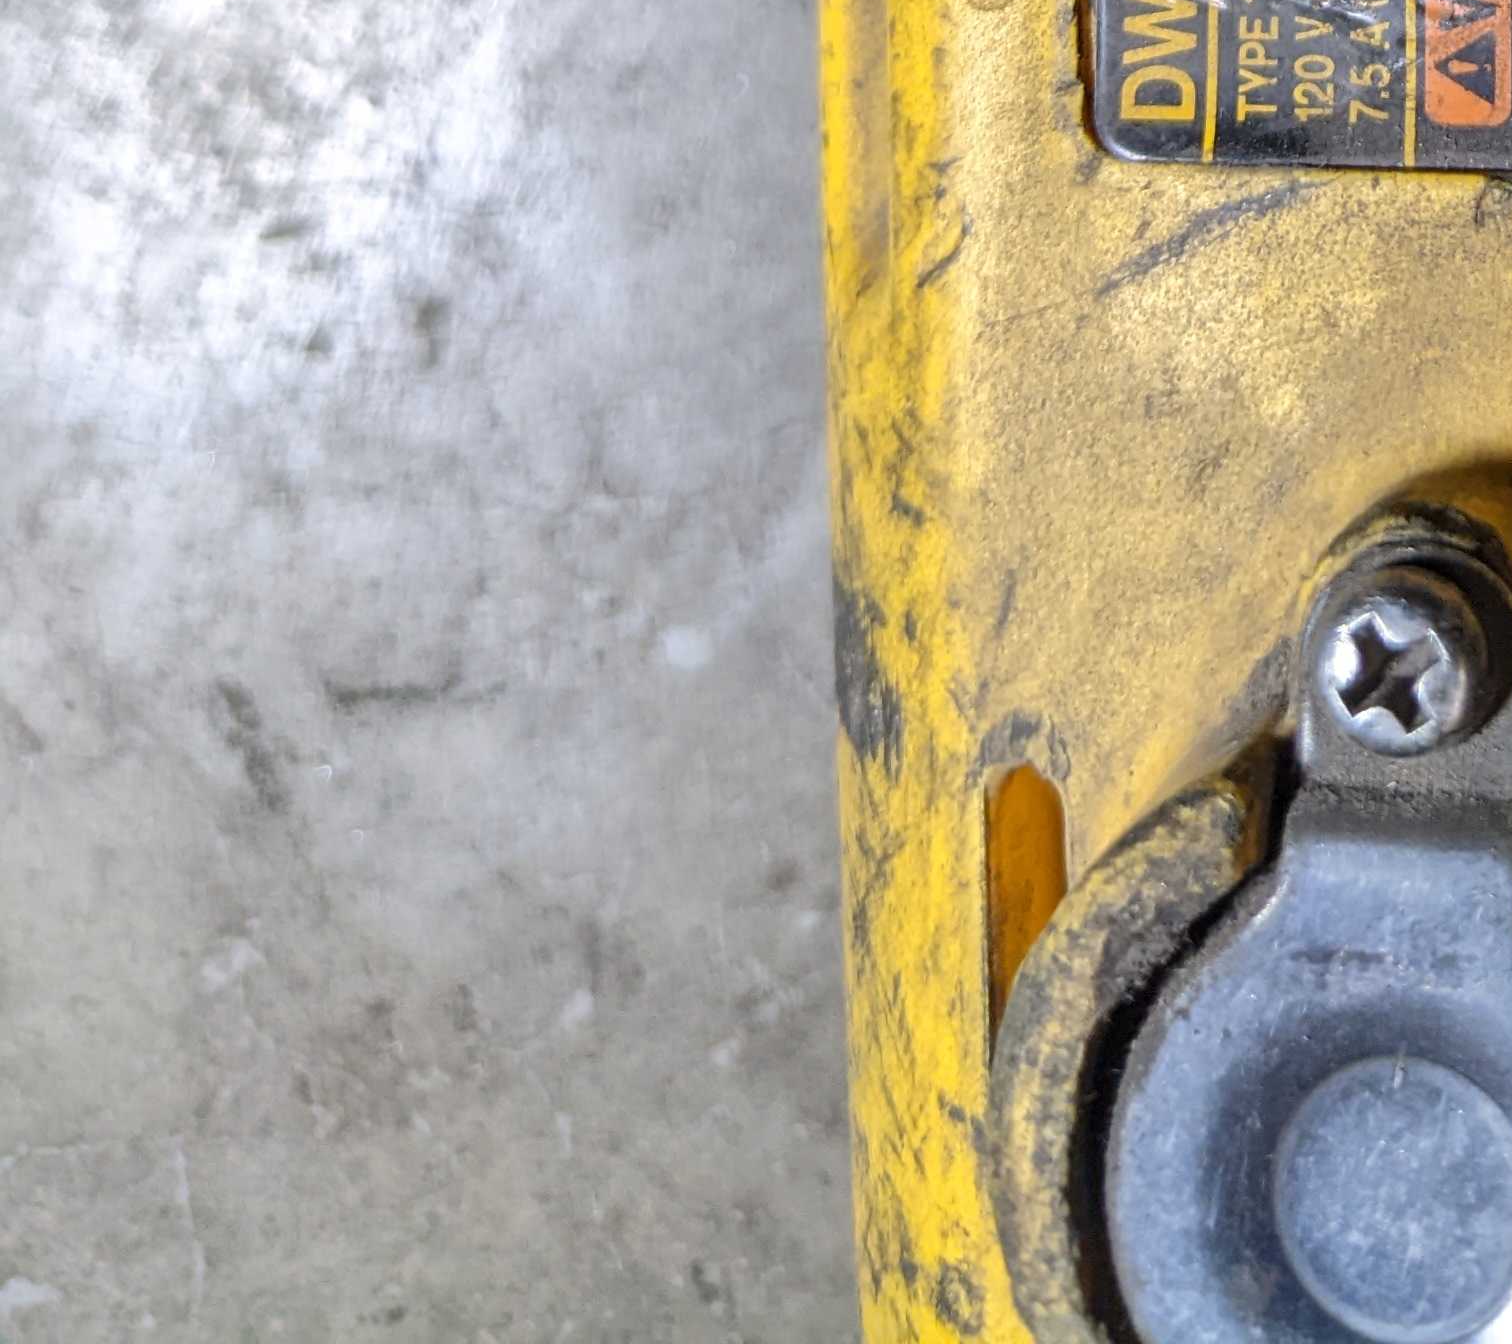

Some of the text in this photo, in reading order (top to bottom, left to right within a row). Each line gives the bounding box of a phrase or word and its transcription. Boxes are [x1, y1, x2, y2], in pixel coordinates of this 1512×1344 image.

[1295, 15, 1335, 39] V
[1349, 20, 1391, 51] A
[1238, 15, 1280, 122] TYPE
[1294, 54, 1336, 122] 120
[1349, 62, 1392, 126] 7.5
